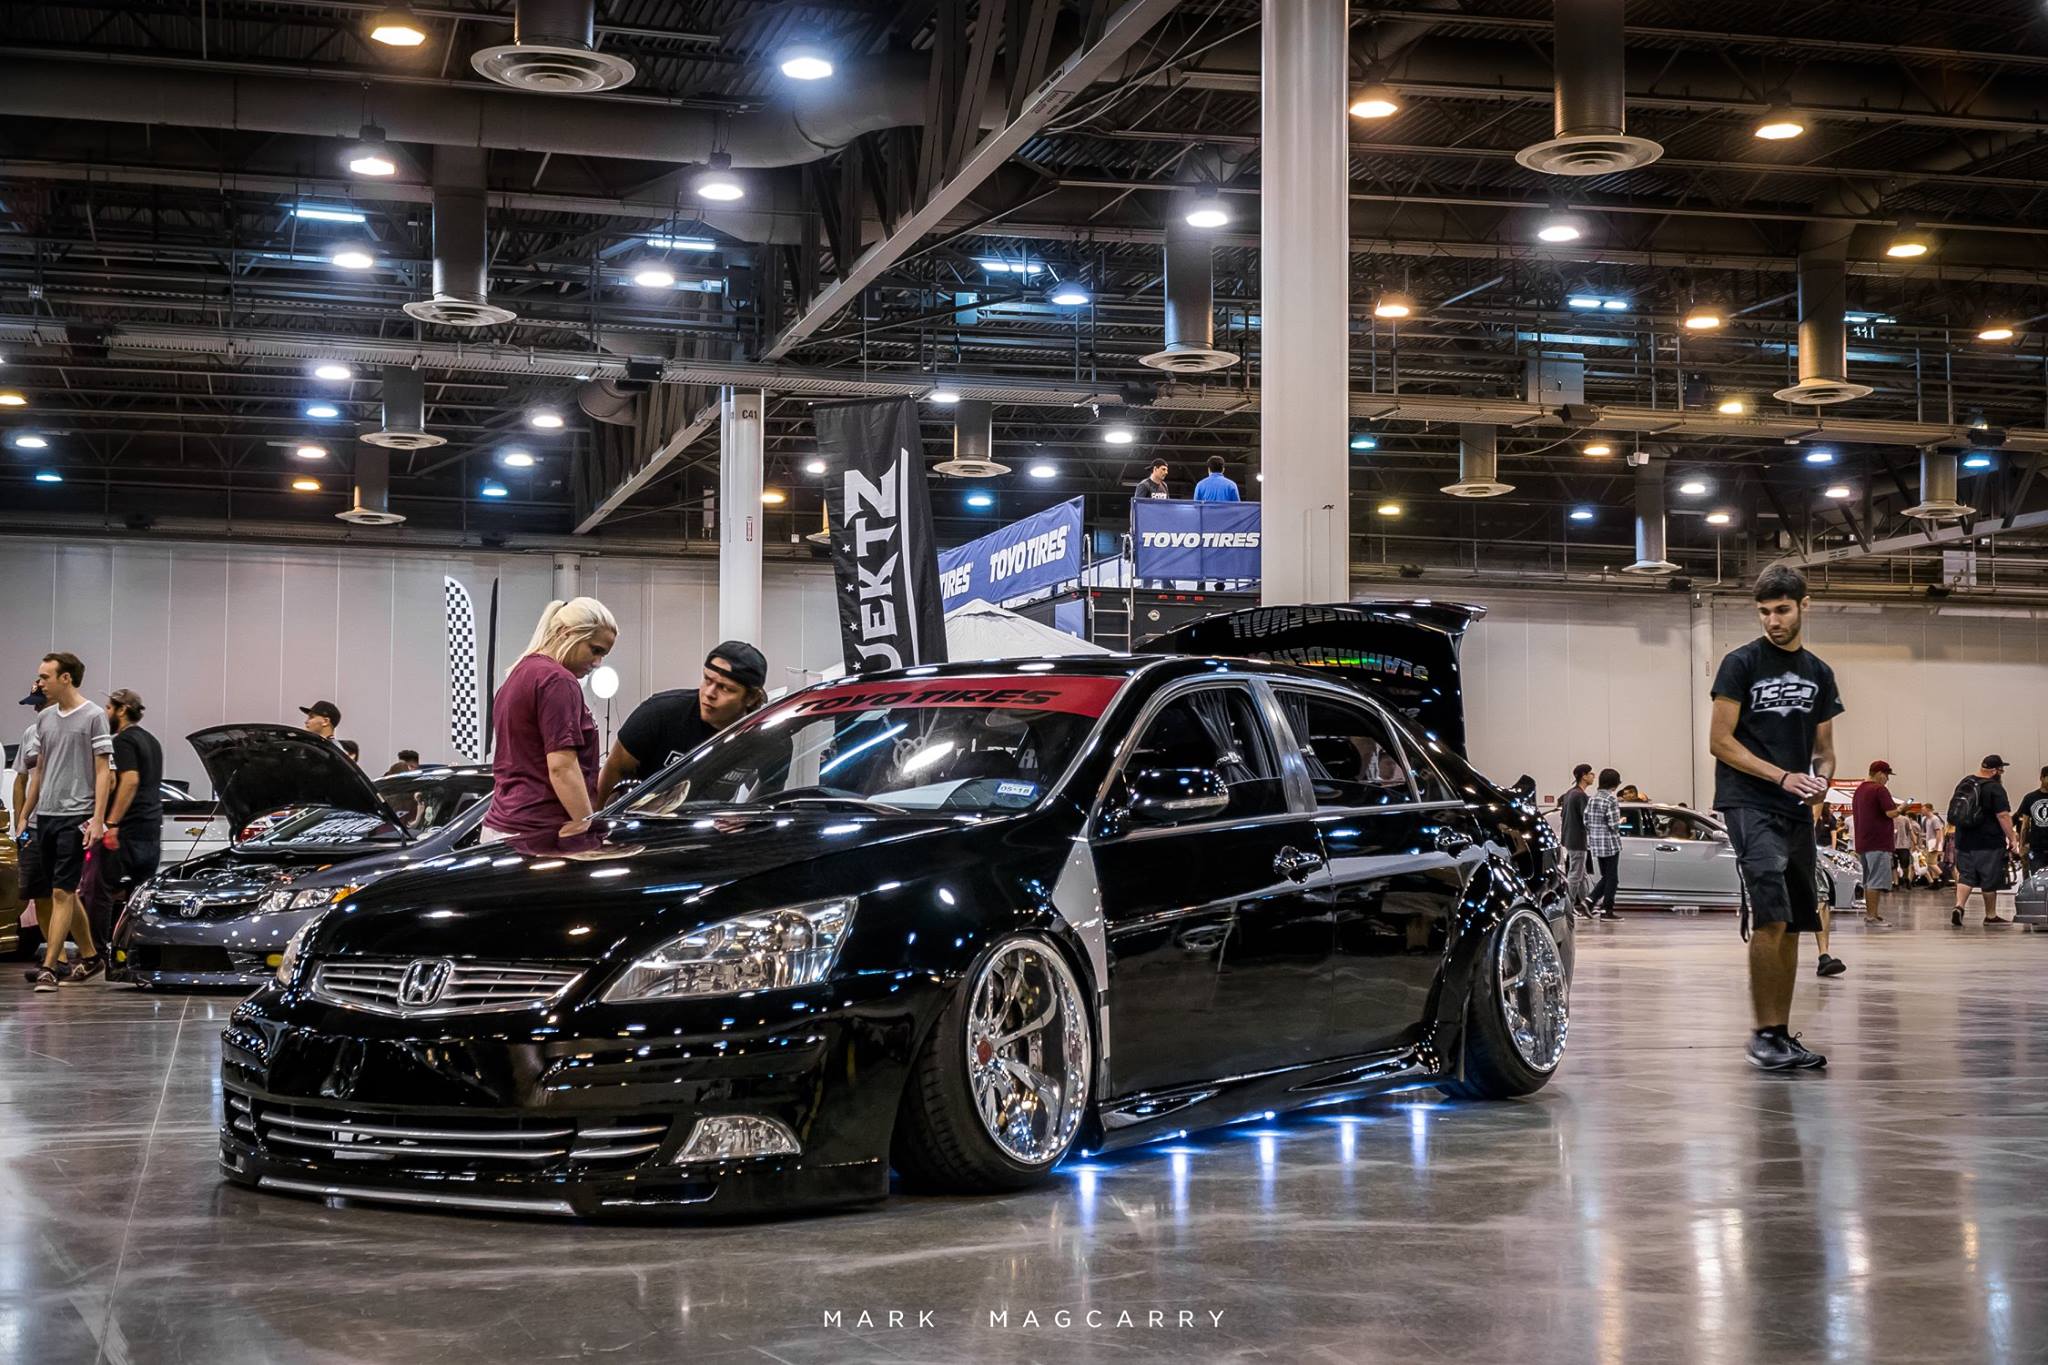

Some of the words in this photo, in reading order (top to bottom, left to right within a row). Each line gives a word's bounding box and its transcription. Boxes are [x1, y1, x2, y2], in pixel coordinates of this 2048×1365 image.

[742, 409, 758, 419] C41
[1142, 532, 1200, 548] TOYO
[1201, 532, 1260, 548] TIRES
[990, 541, 1027, 583] TOYO
[1027, 525, 1068, 569] TIRES
[939, 562, 971, 600] TIRES
[794, 690, 910, 713] TOYO
[911, 689, 1063, 706] TIRES
[1752, 682, 1817, 703] 1320
